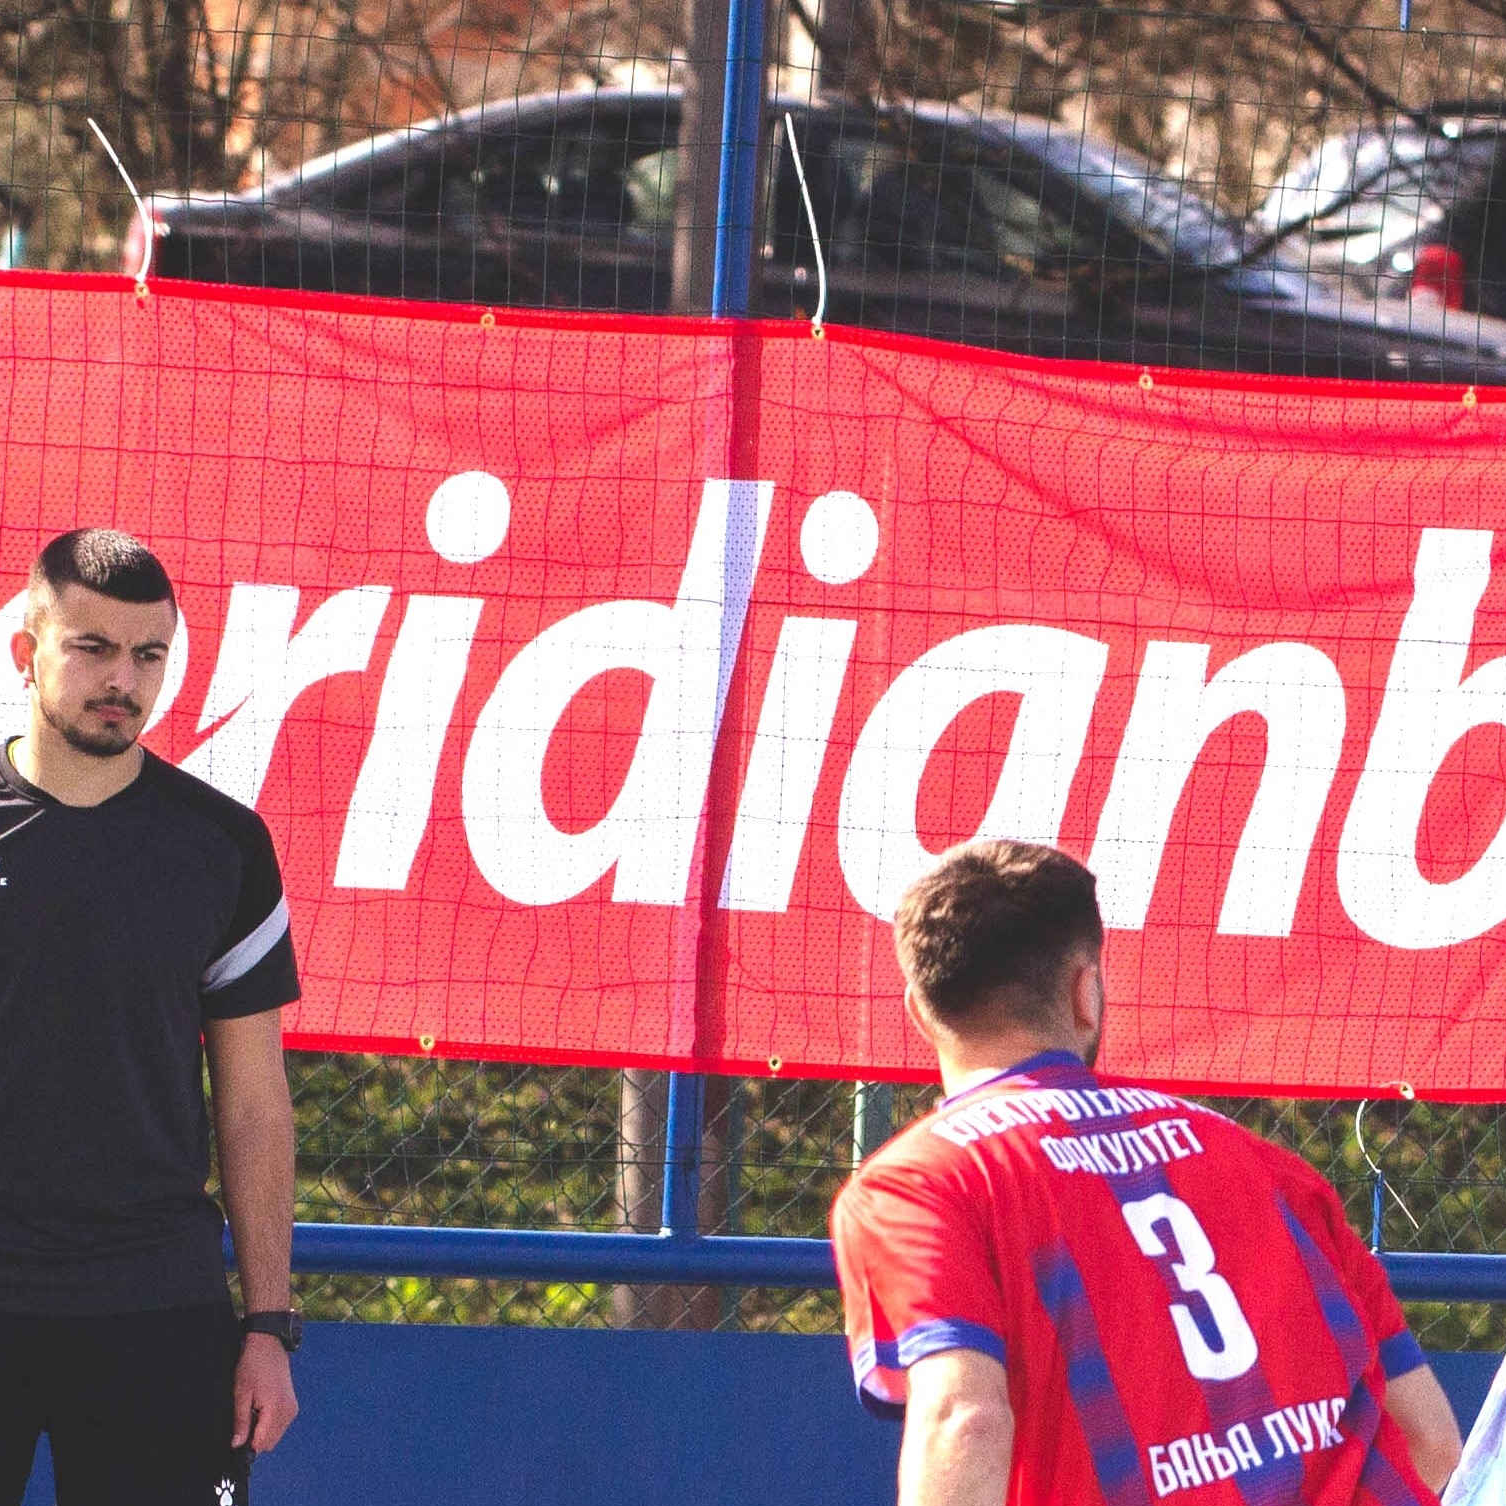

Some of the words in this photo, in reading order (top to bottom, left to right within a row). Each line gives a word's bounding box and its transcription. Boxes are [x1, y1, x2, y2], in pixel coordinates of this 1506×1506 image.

[1039, 1118, 1204, 1174] ФАКУЛТЕТ
[1121, 1191, 1259, 1381] 3
[1148, 1422, 1263, 1498] БАЊА
